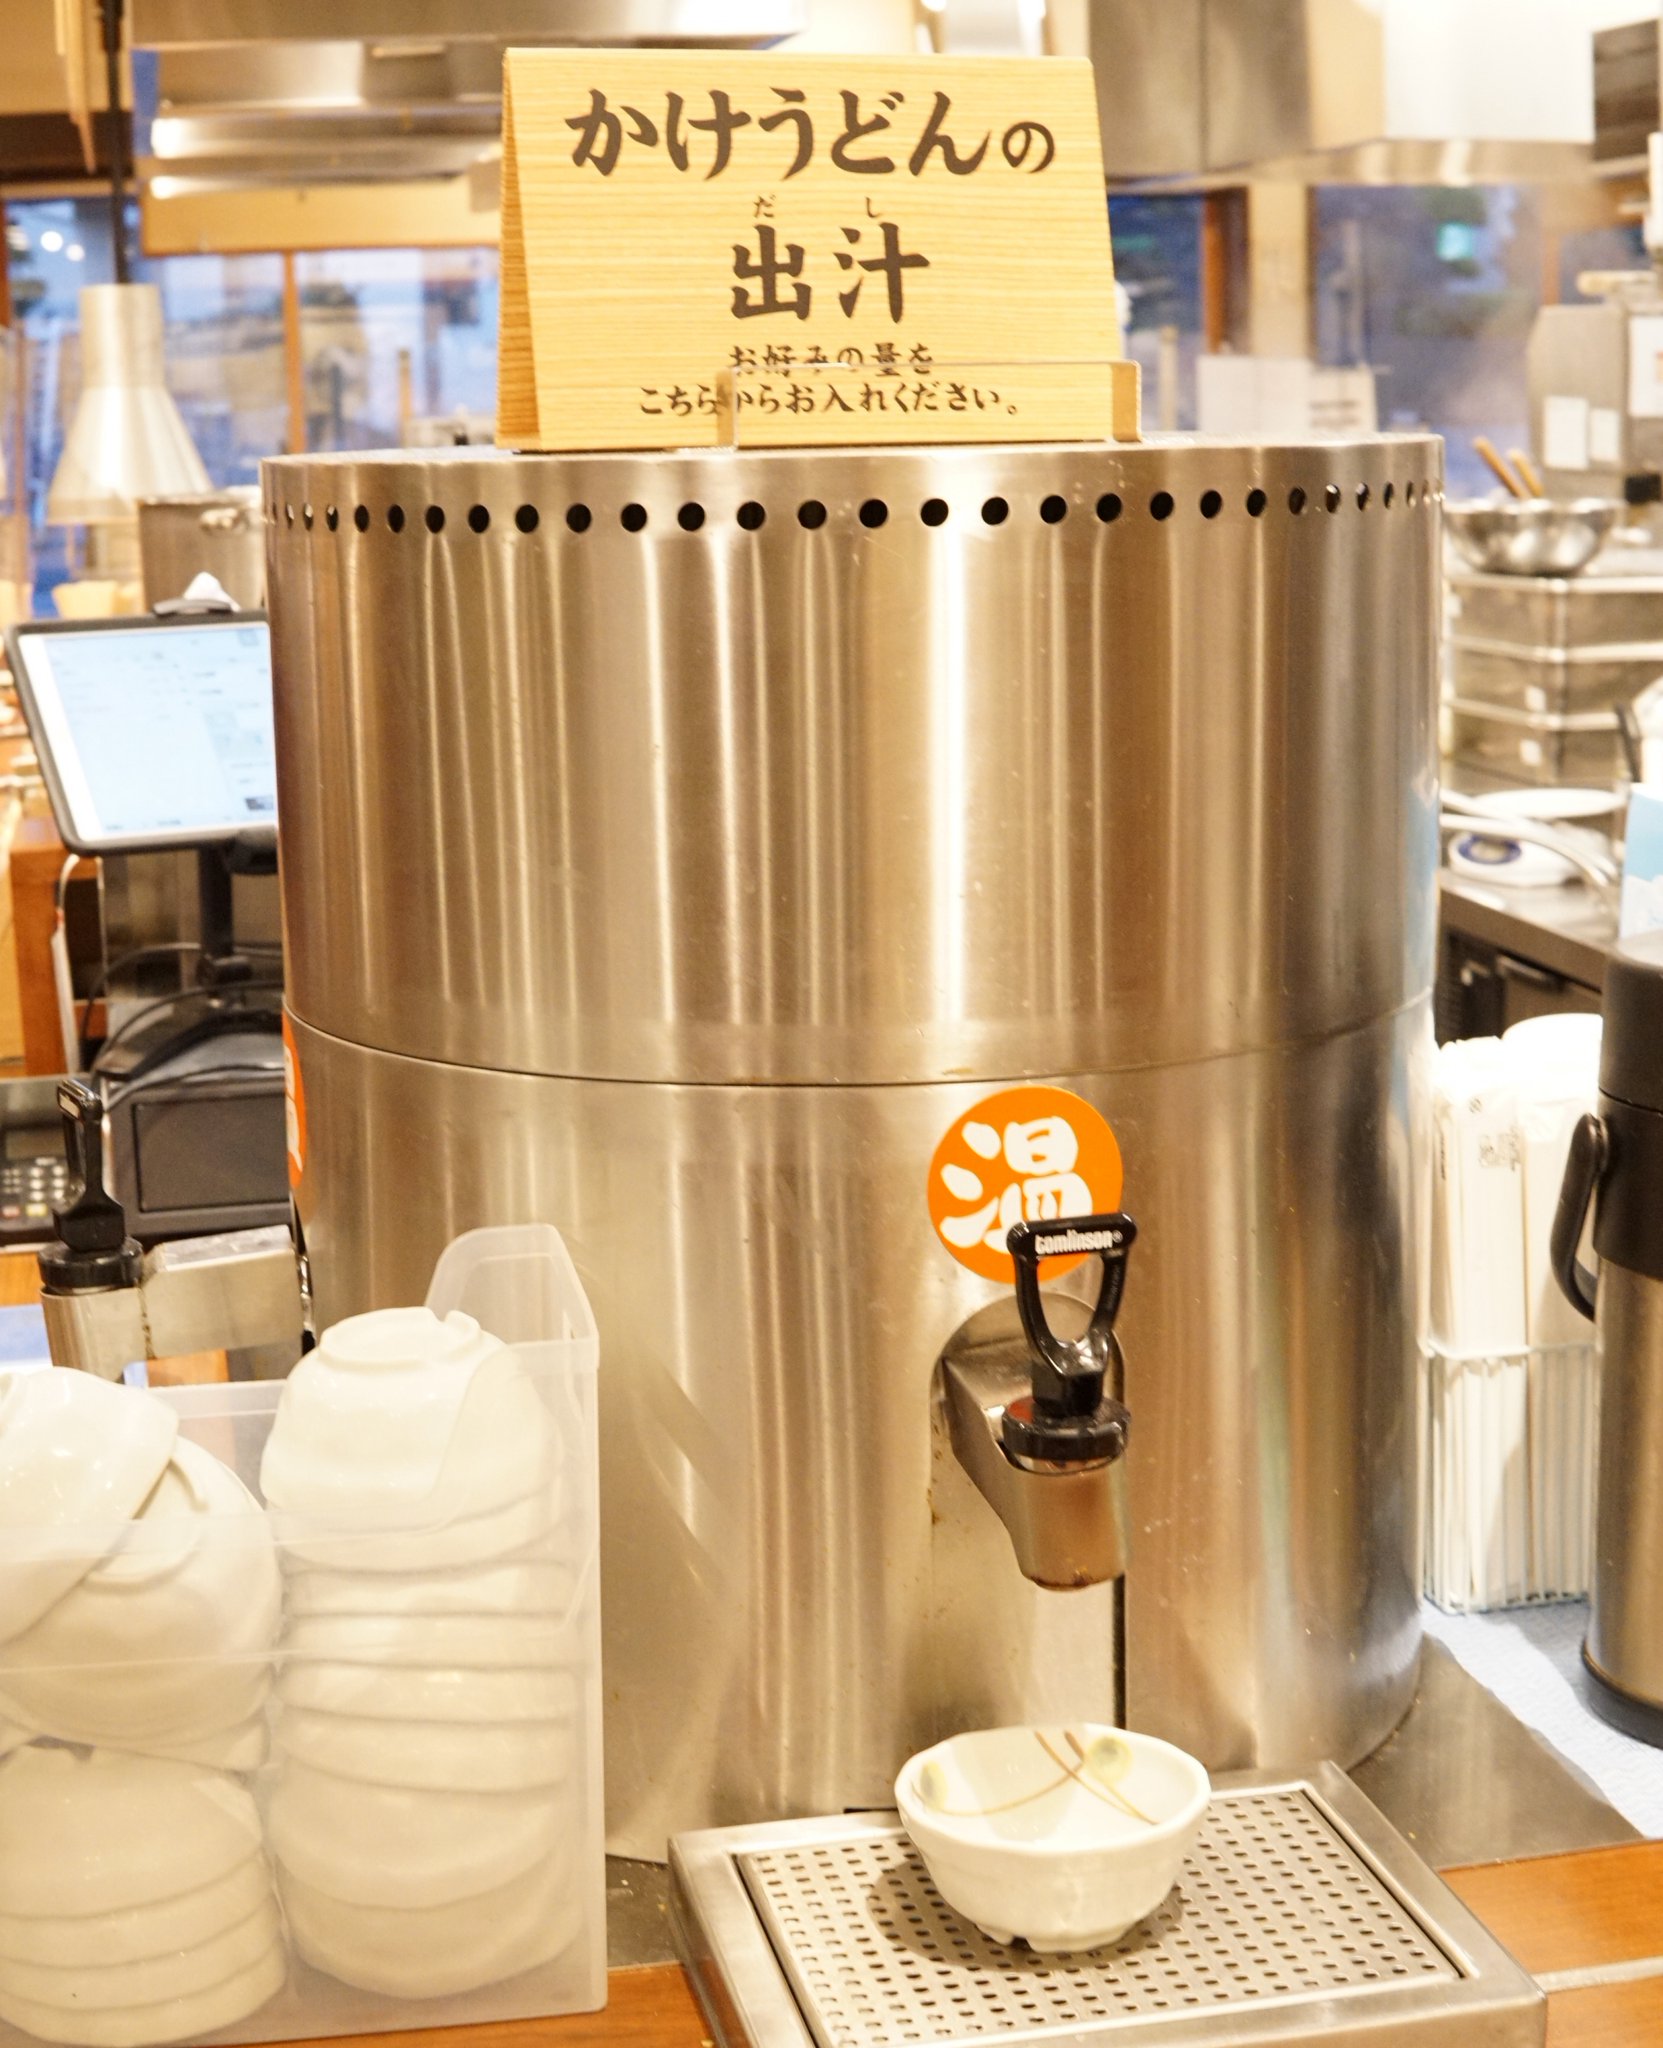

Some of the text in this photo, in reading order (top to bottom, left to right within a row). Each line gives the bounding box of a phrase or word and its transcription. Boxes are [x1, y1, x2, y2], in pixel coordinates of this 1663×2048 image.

[565, 88, 1055, 179] かけうどんの
[731, 223, 930, 324] 出汁
